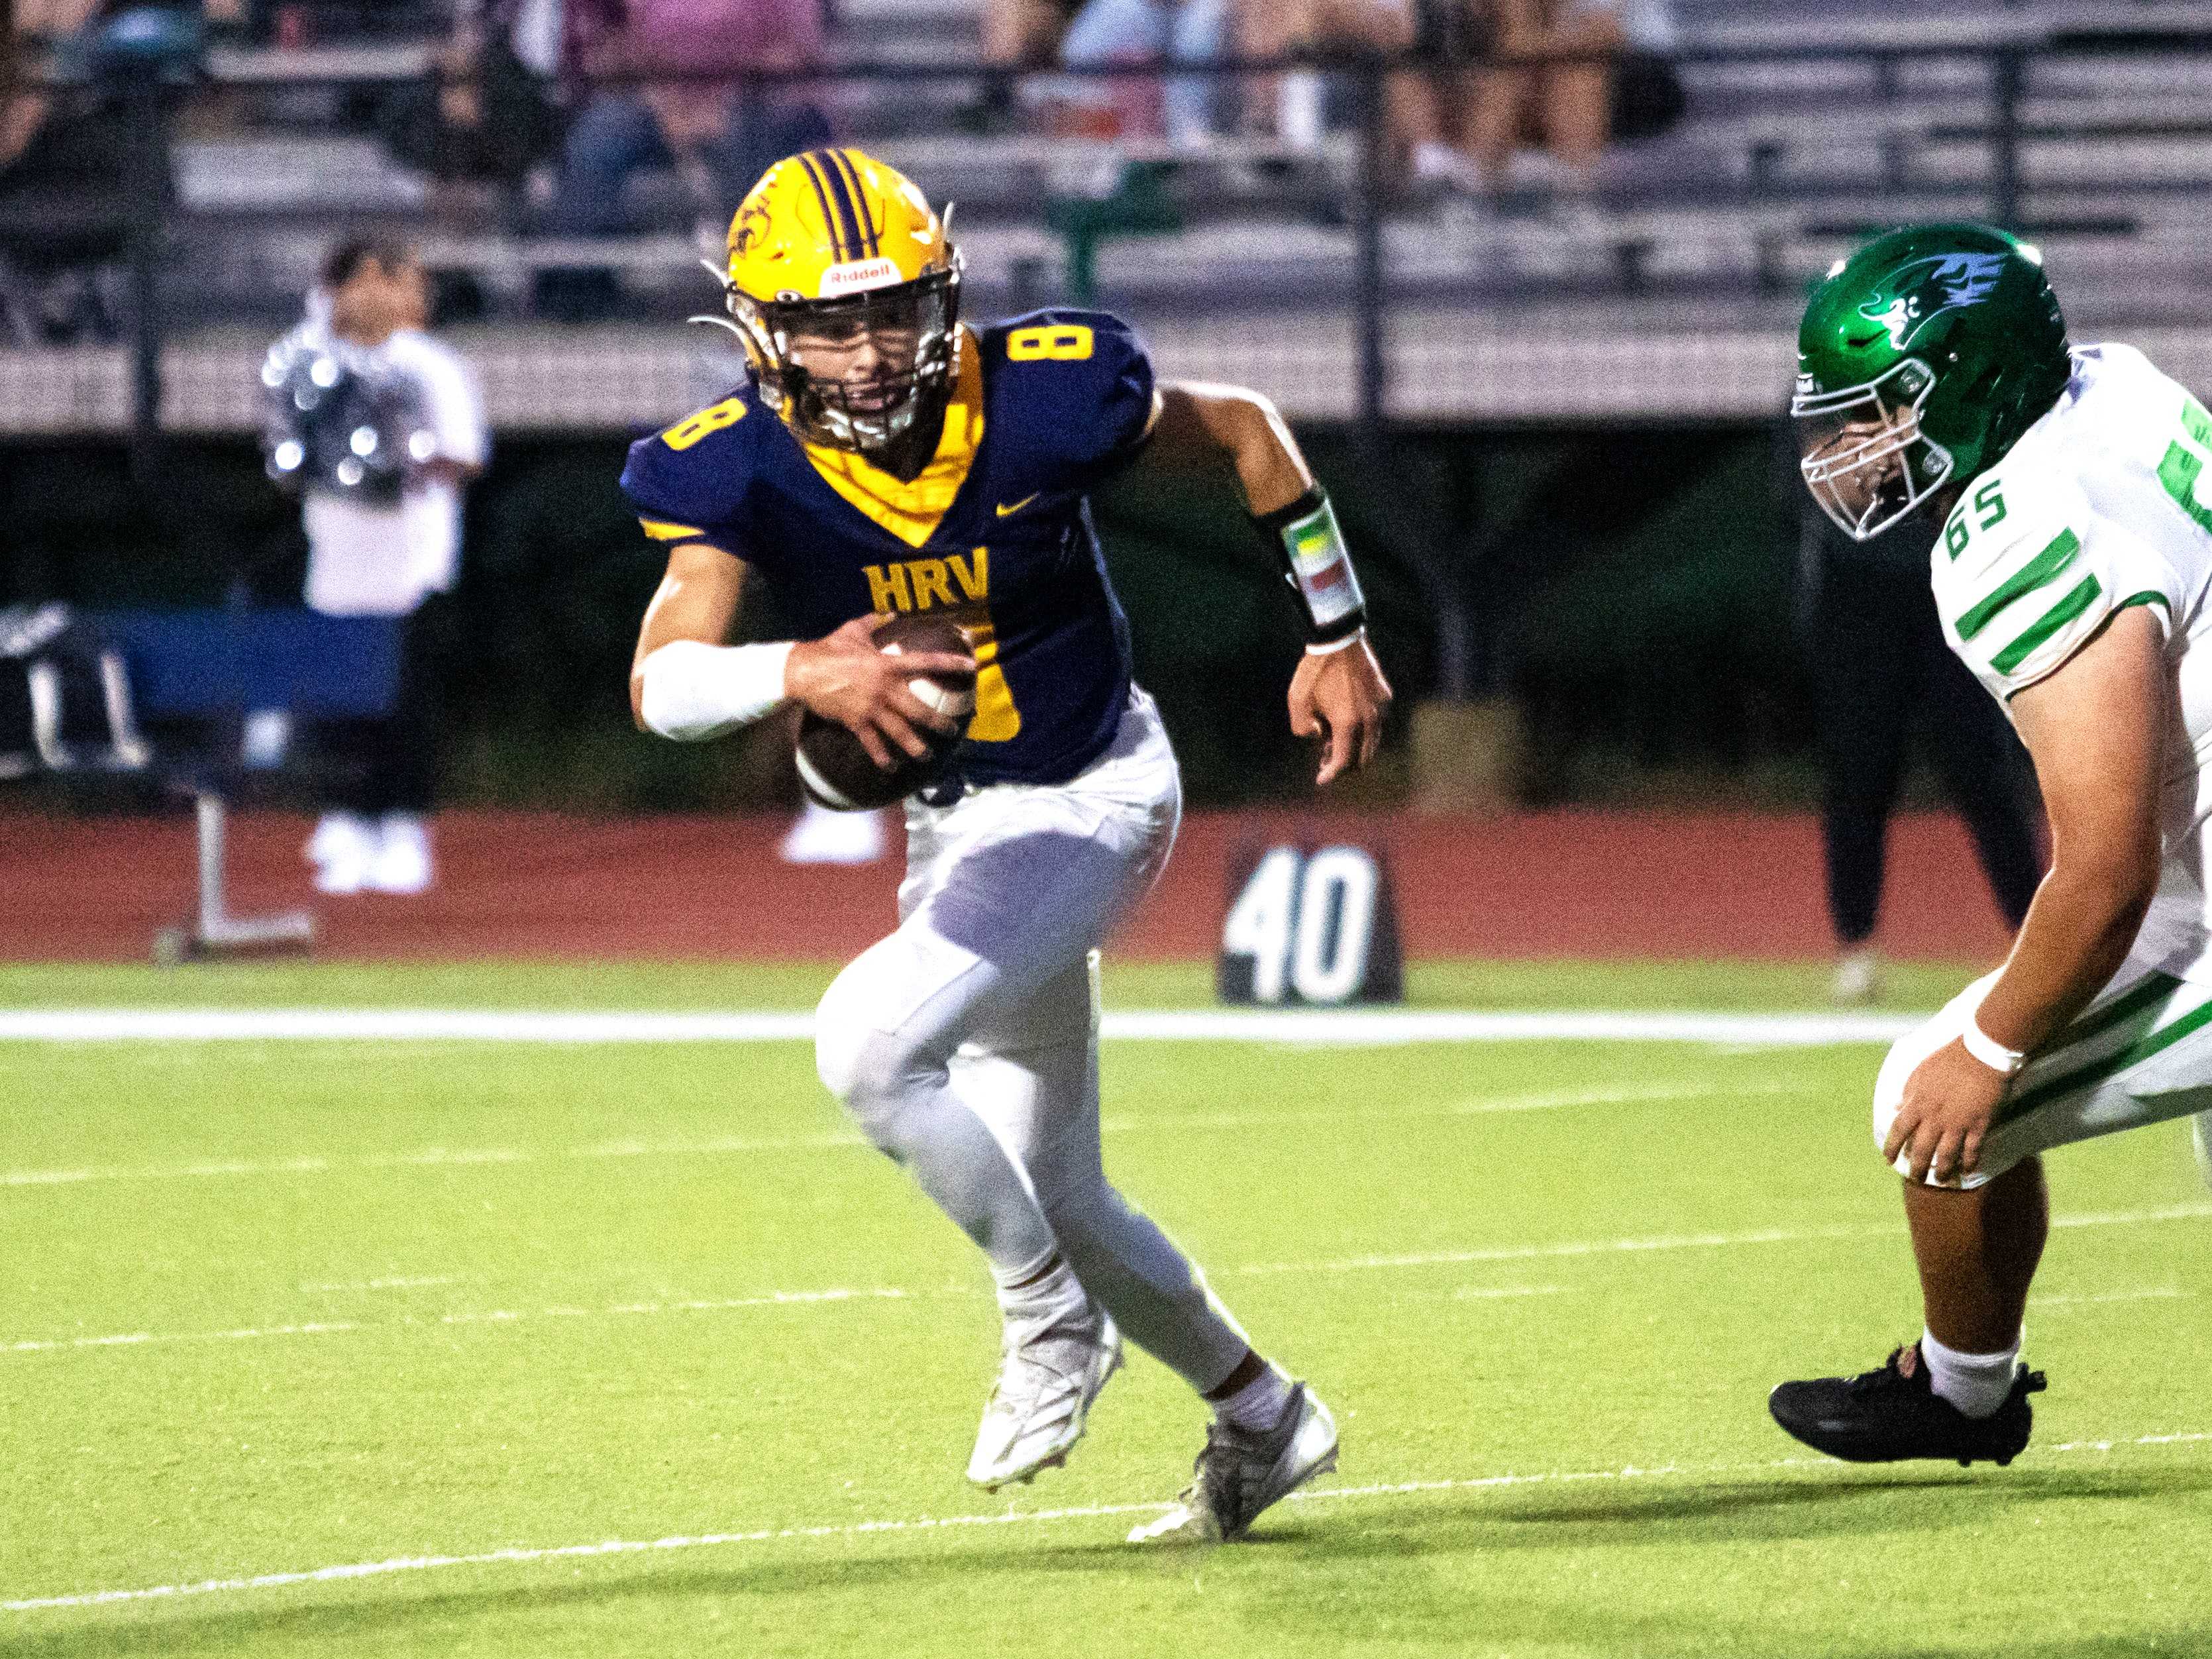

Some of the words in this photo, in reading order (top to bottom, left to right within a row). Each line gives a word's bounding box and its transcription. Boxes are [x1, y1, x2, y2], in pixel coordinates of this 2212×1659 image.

[831, 264, 890, 283] Riddell
[1006, 325, 1094, 361] 8
[662, 398, 747, 451] 8
[1946, 478, 2007, 562] 65
[862, 546, 991, 614] HRV
[1223, 845, 1379, 1002] 40
